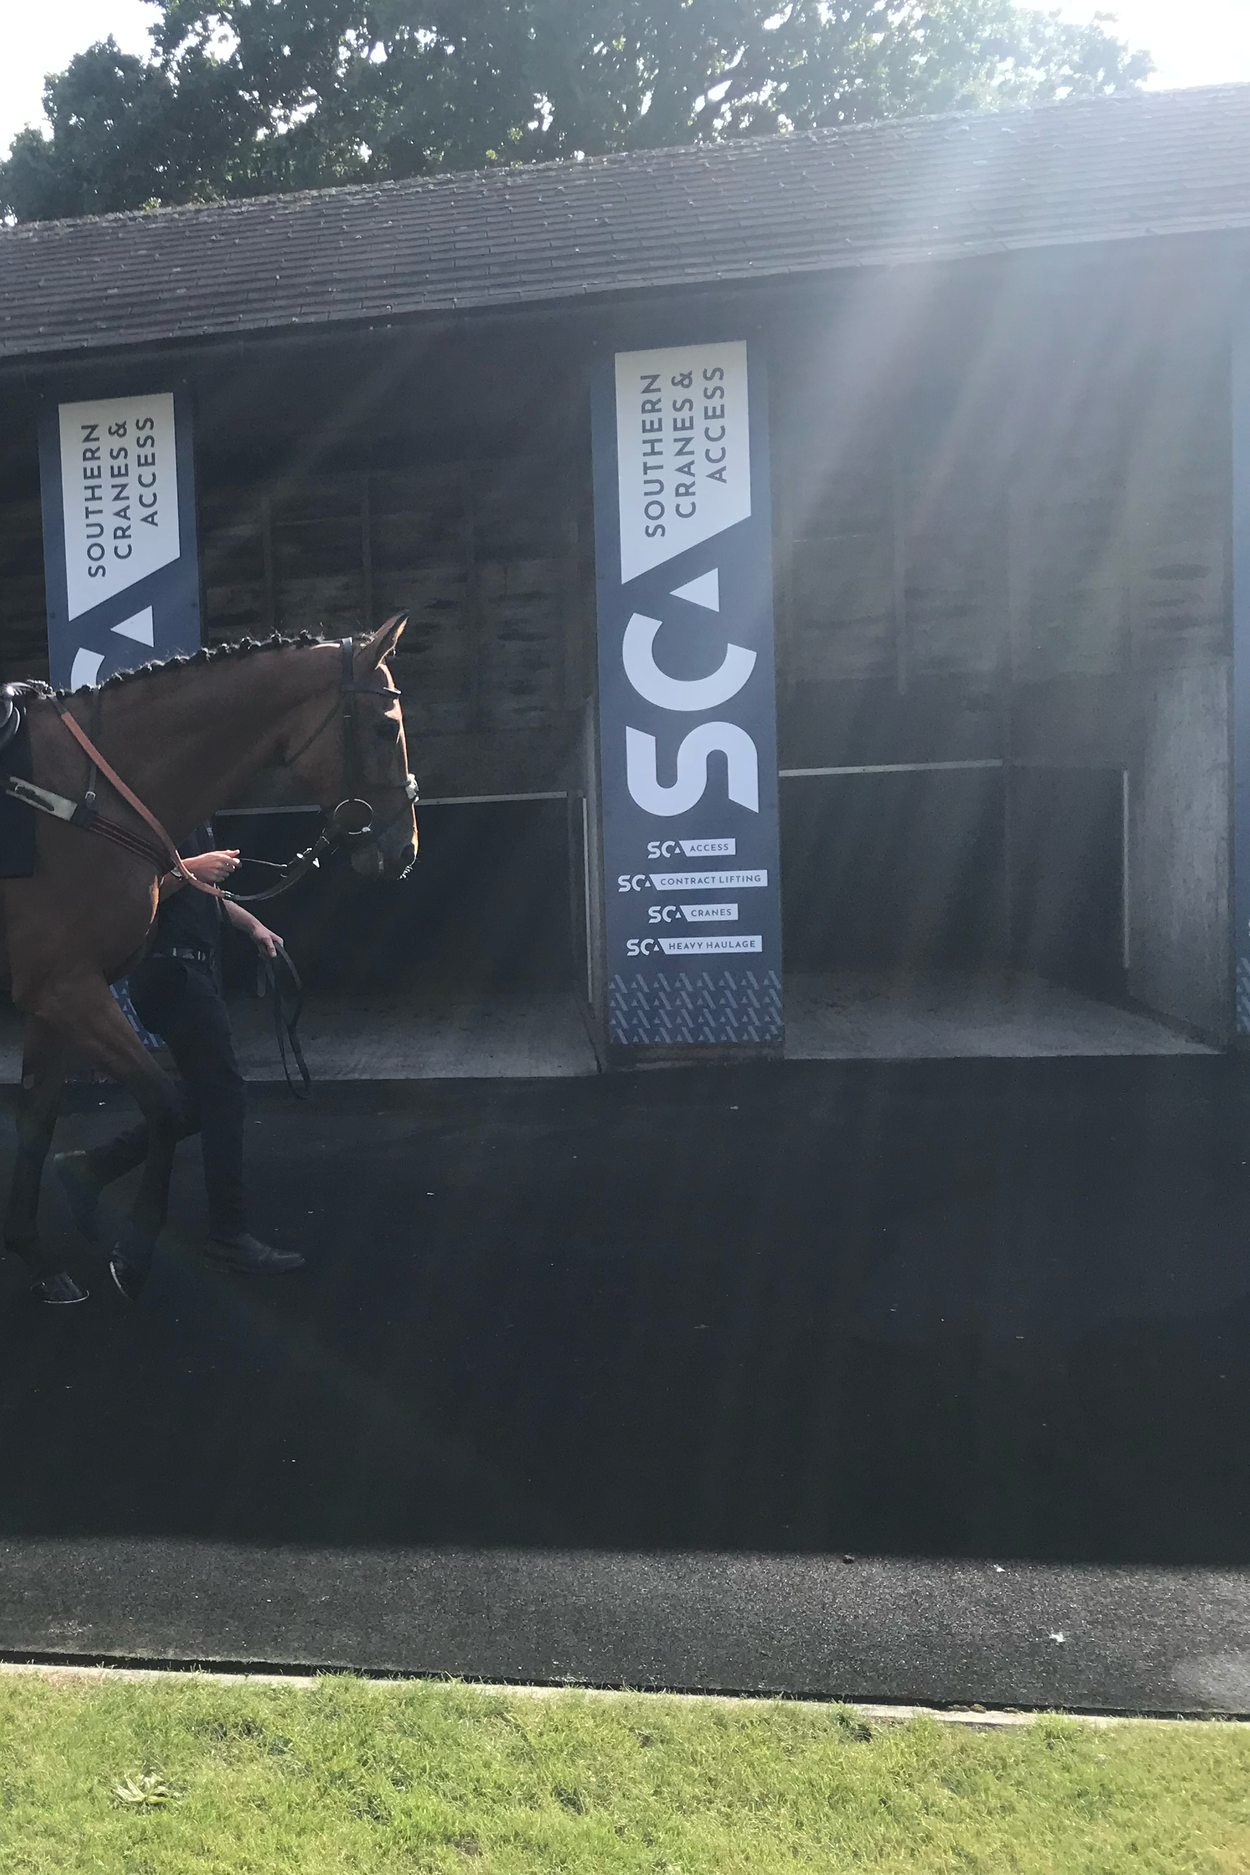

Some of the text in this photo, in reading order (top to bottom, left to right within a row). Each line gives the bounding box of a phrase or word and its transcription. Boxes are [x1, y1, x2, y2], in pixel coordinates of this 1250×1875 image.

[135, 417, 158, 526] ACCESS
[640, 373, 665, 538] SOUTHERN
[670, 369, 697, 518] CRANES &
[702, 366, 727, 484] ACCESS
[81, 424, 106, 577] SOUTHERN
[108, 420, 133, 560] CRANES &
[660, 876, 716, 886] CONTRACT
[719, 874, 762, 884] LIFTING
[689, 843, 729, 853] ACCESS
[668, 942, 703, 950] HEAVY
[706, 940, 756, 949] HAULAGE
[690, 908, 732, 917] CRANES
